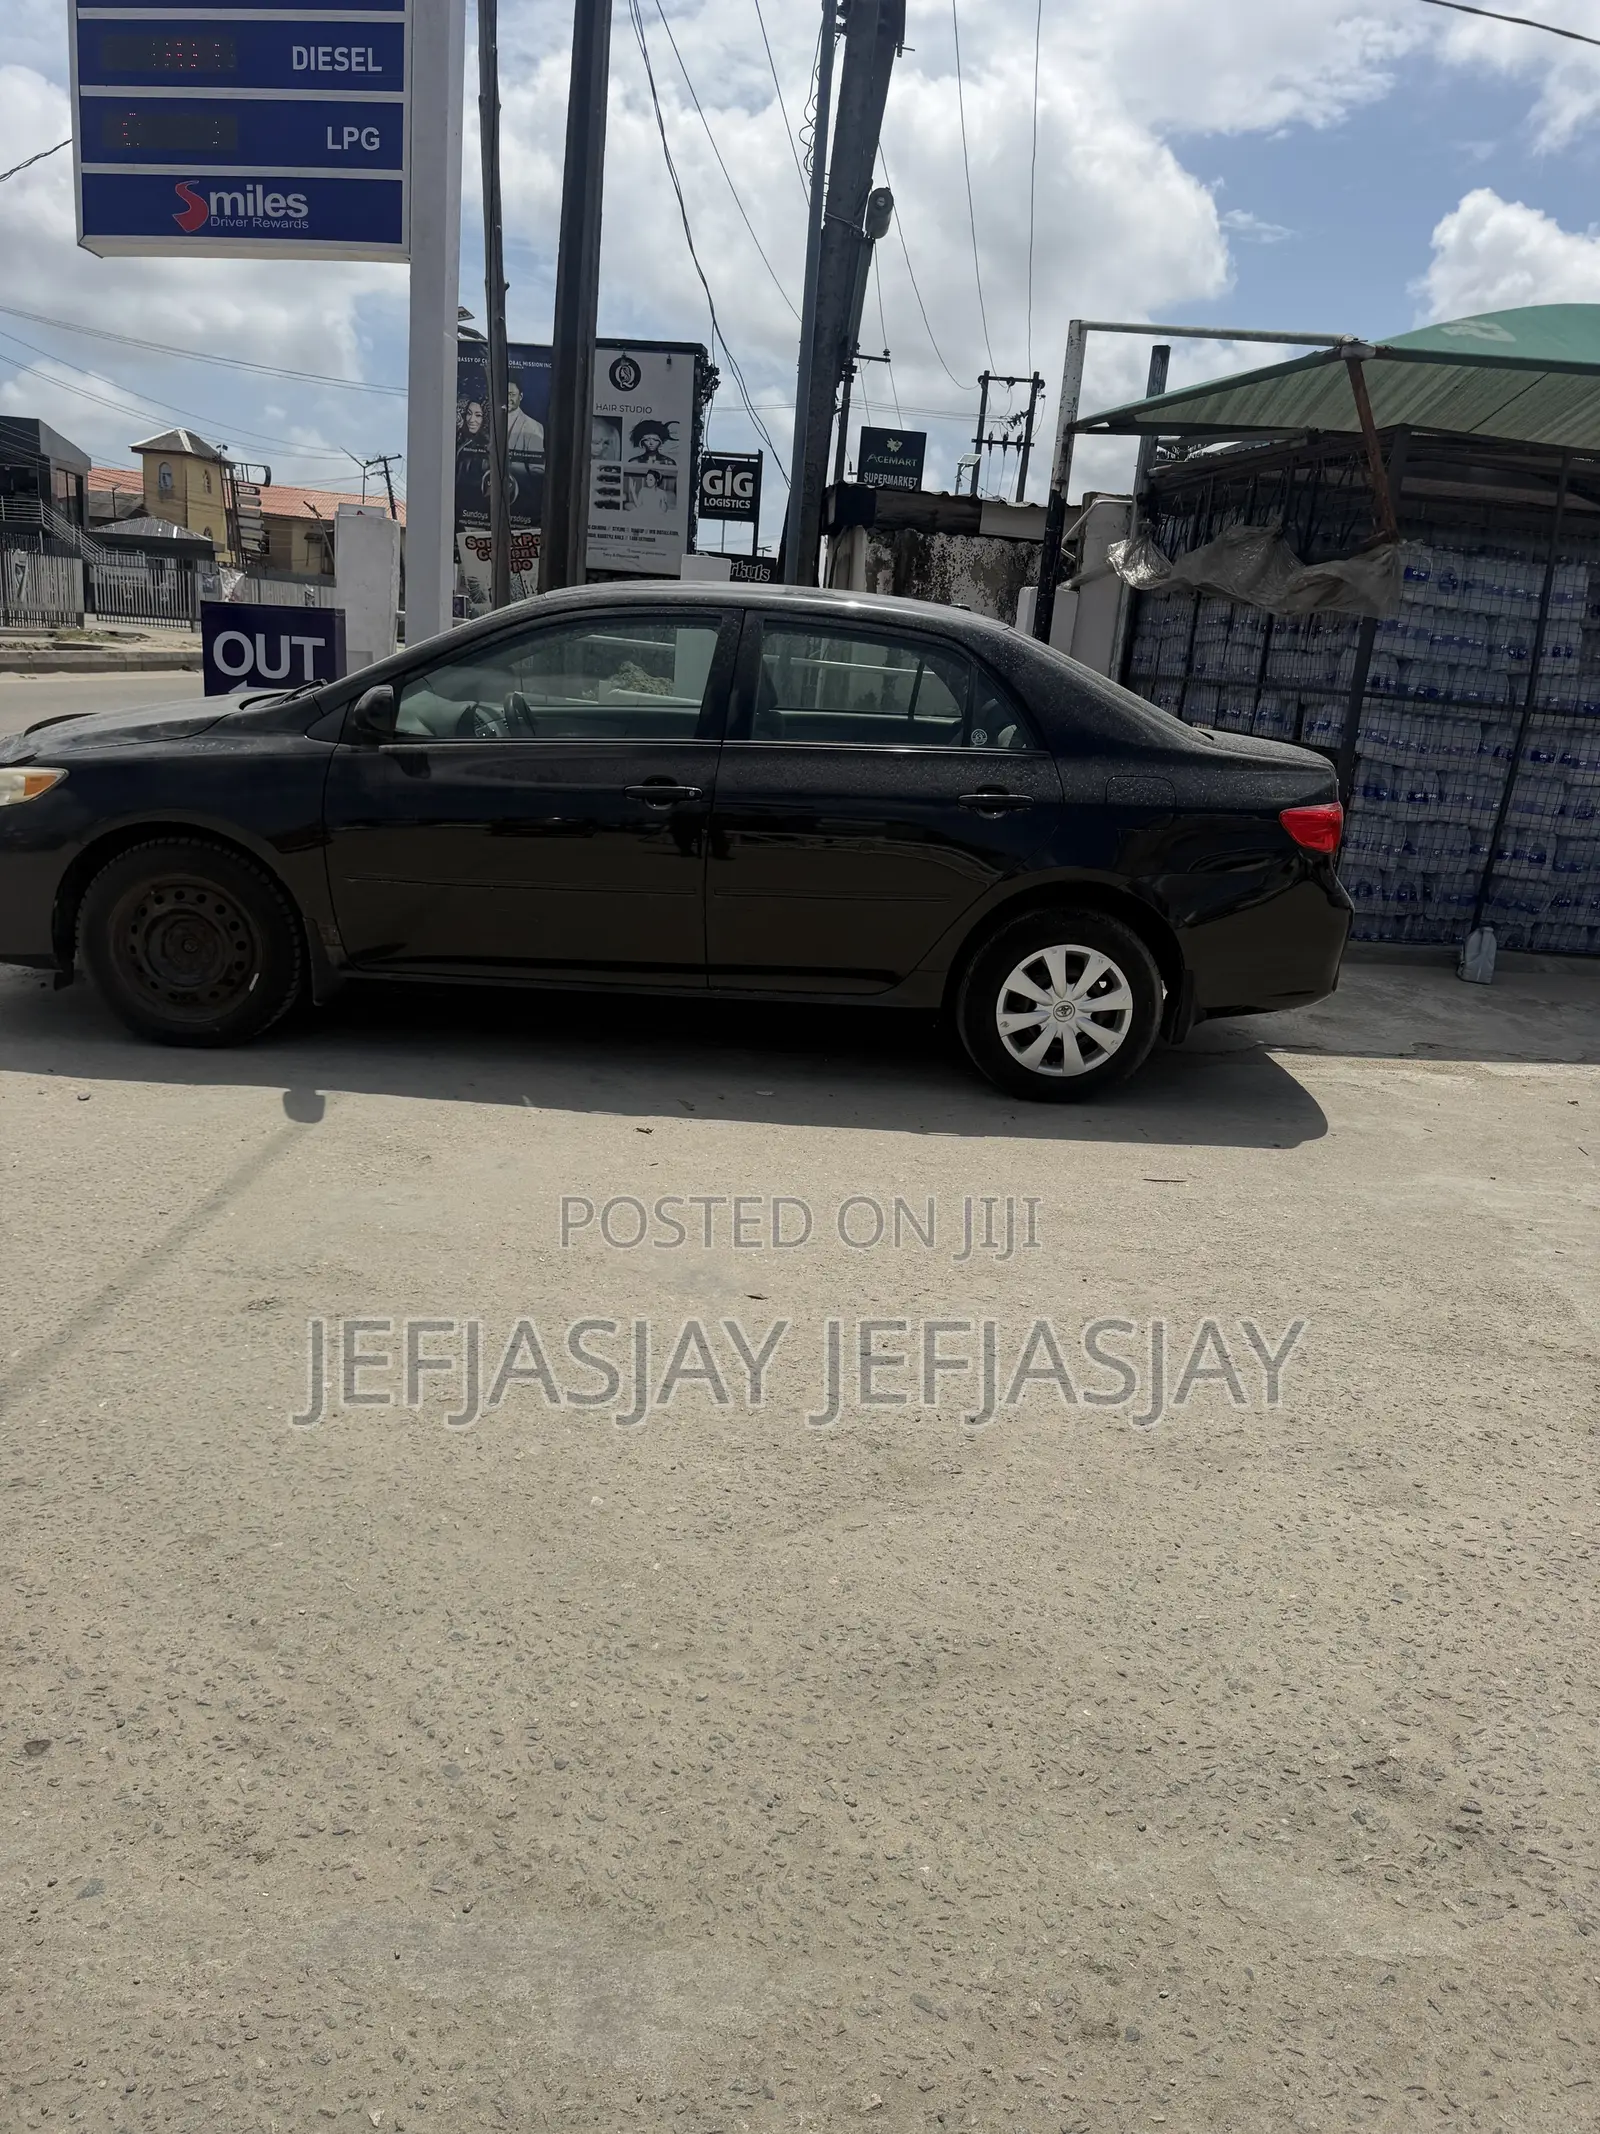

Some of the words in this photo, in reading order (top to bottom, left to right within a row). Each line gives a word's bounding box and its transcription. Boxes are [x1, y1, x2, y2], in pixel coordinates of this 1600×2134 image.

[292, 45, 382, 72] DIESEL
[326, 126, 380, 150] LPG
[172, 180, 309, 233] Smiles
[210, 216, 248, 228] Driver
[252, 217, 309, 229] Rewards
[595, 403, 617, 412] HAIR
[619, 404, 653, 414] STUDIO
[867, 453, 918, 467] ACEMART
[702, 469, 754, 498] GIG
[863, 472, 918, 488] SUPERMARKET
[704, 497, 751, 509] LOGISTICS
[213, 630, 325, 680] OUT
